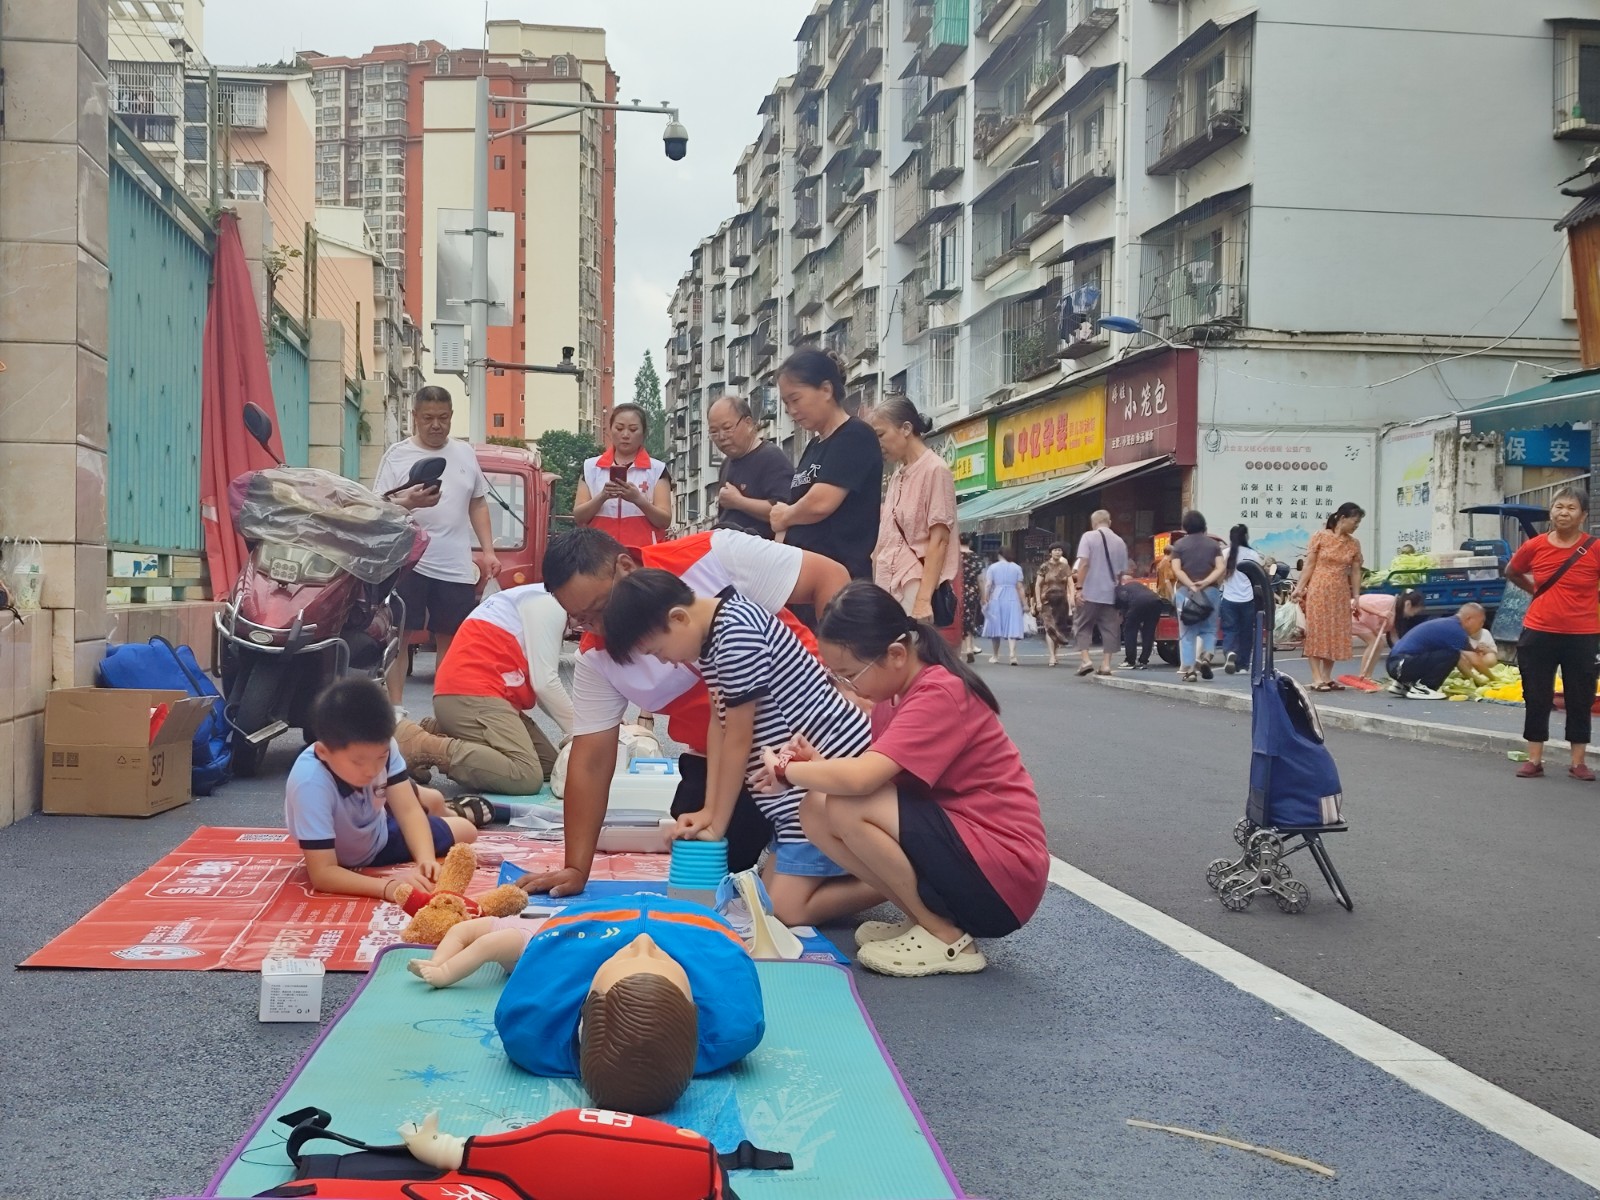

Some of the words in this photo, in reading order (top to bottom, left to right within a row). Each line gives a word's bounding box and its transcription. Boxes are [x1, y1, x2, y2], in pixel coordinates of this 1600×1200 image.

[1124, 378, 1168, 420] 小笼包
[1506, 436, 1570, 463] 保安
[1240, 483, 1258, 492] 富强
[1266, 483, 1283, 492] 民主
[1290, 484, 1308, 493] 文明
[1316, 484, 1333, 493] 和谐
[1240, 496, 1258, 505] 自由
[1266, 496, 1283, 505] 平等
[1290, 496, 1308, 505] 公正
[1316, 496, 1333, 505] 法治
[1240, 510, 1258, 520] 爱国
[1266, 510, 1283, 520] 敬业
[1290, 510, 1308, 520] 诚信
